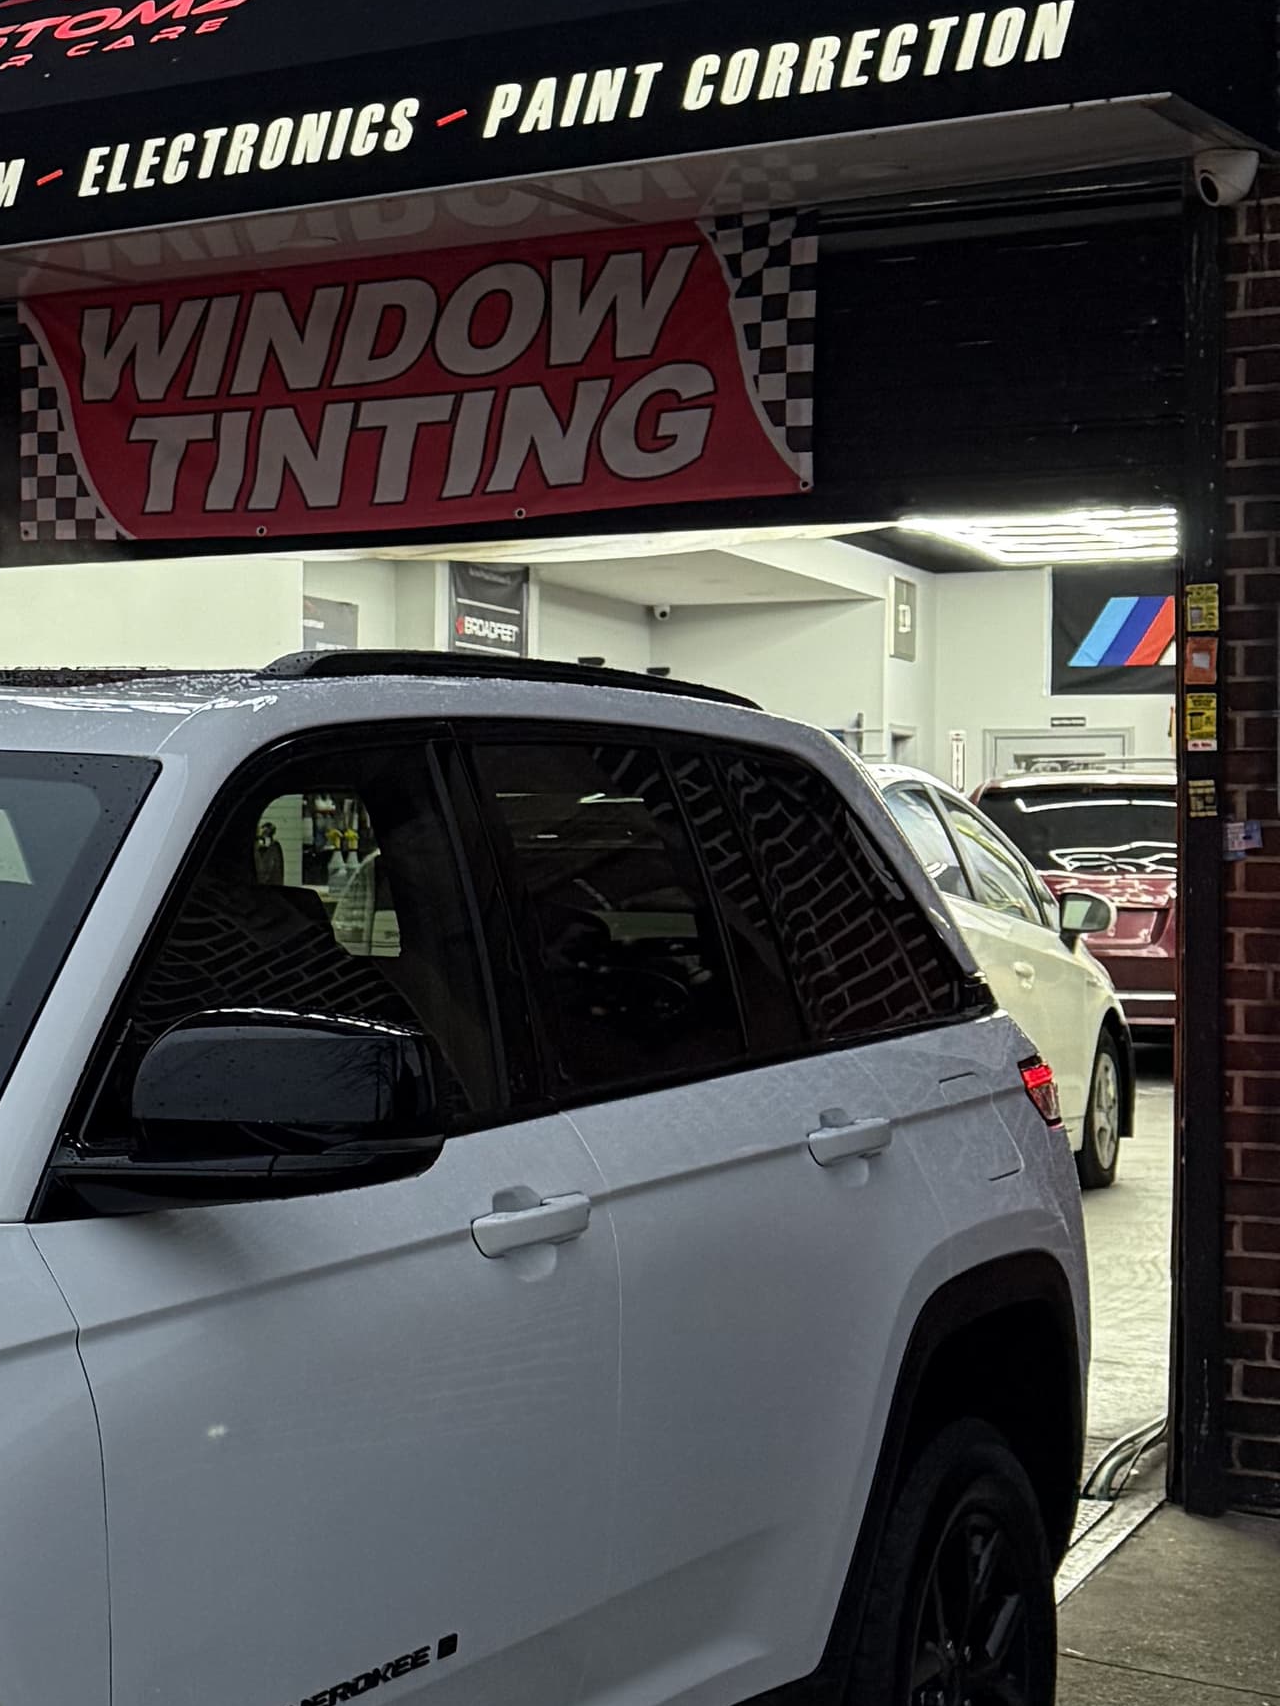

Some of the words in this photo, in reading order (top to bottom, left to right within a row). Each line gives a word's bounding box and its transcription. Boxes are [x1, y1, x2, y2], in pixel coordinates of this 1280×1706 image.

[65, 16, 230, 58] CARE
[76, 96, 421, 200] ELECTRONICS
[481, 61, 662, 140] PAINT
[78, 242, 702, 405] WINDOW
[126, 360, 717, 516] TINTING
